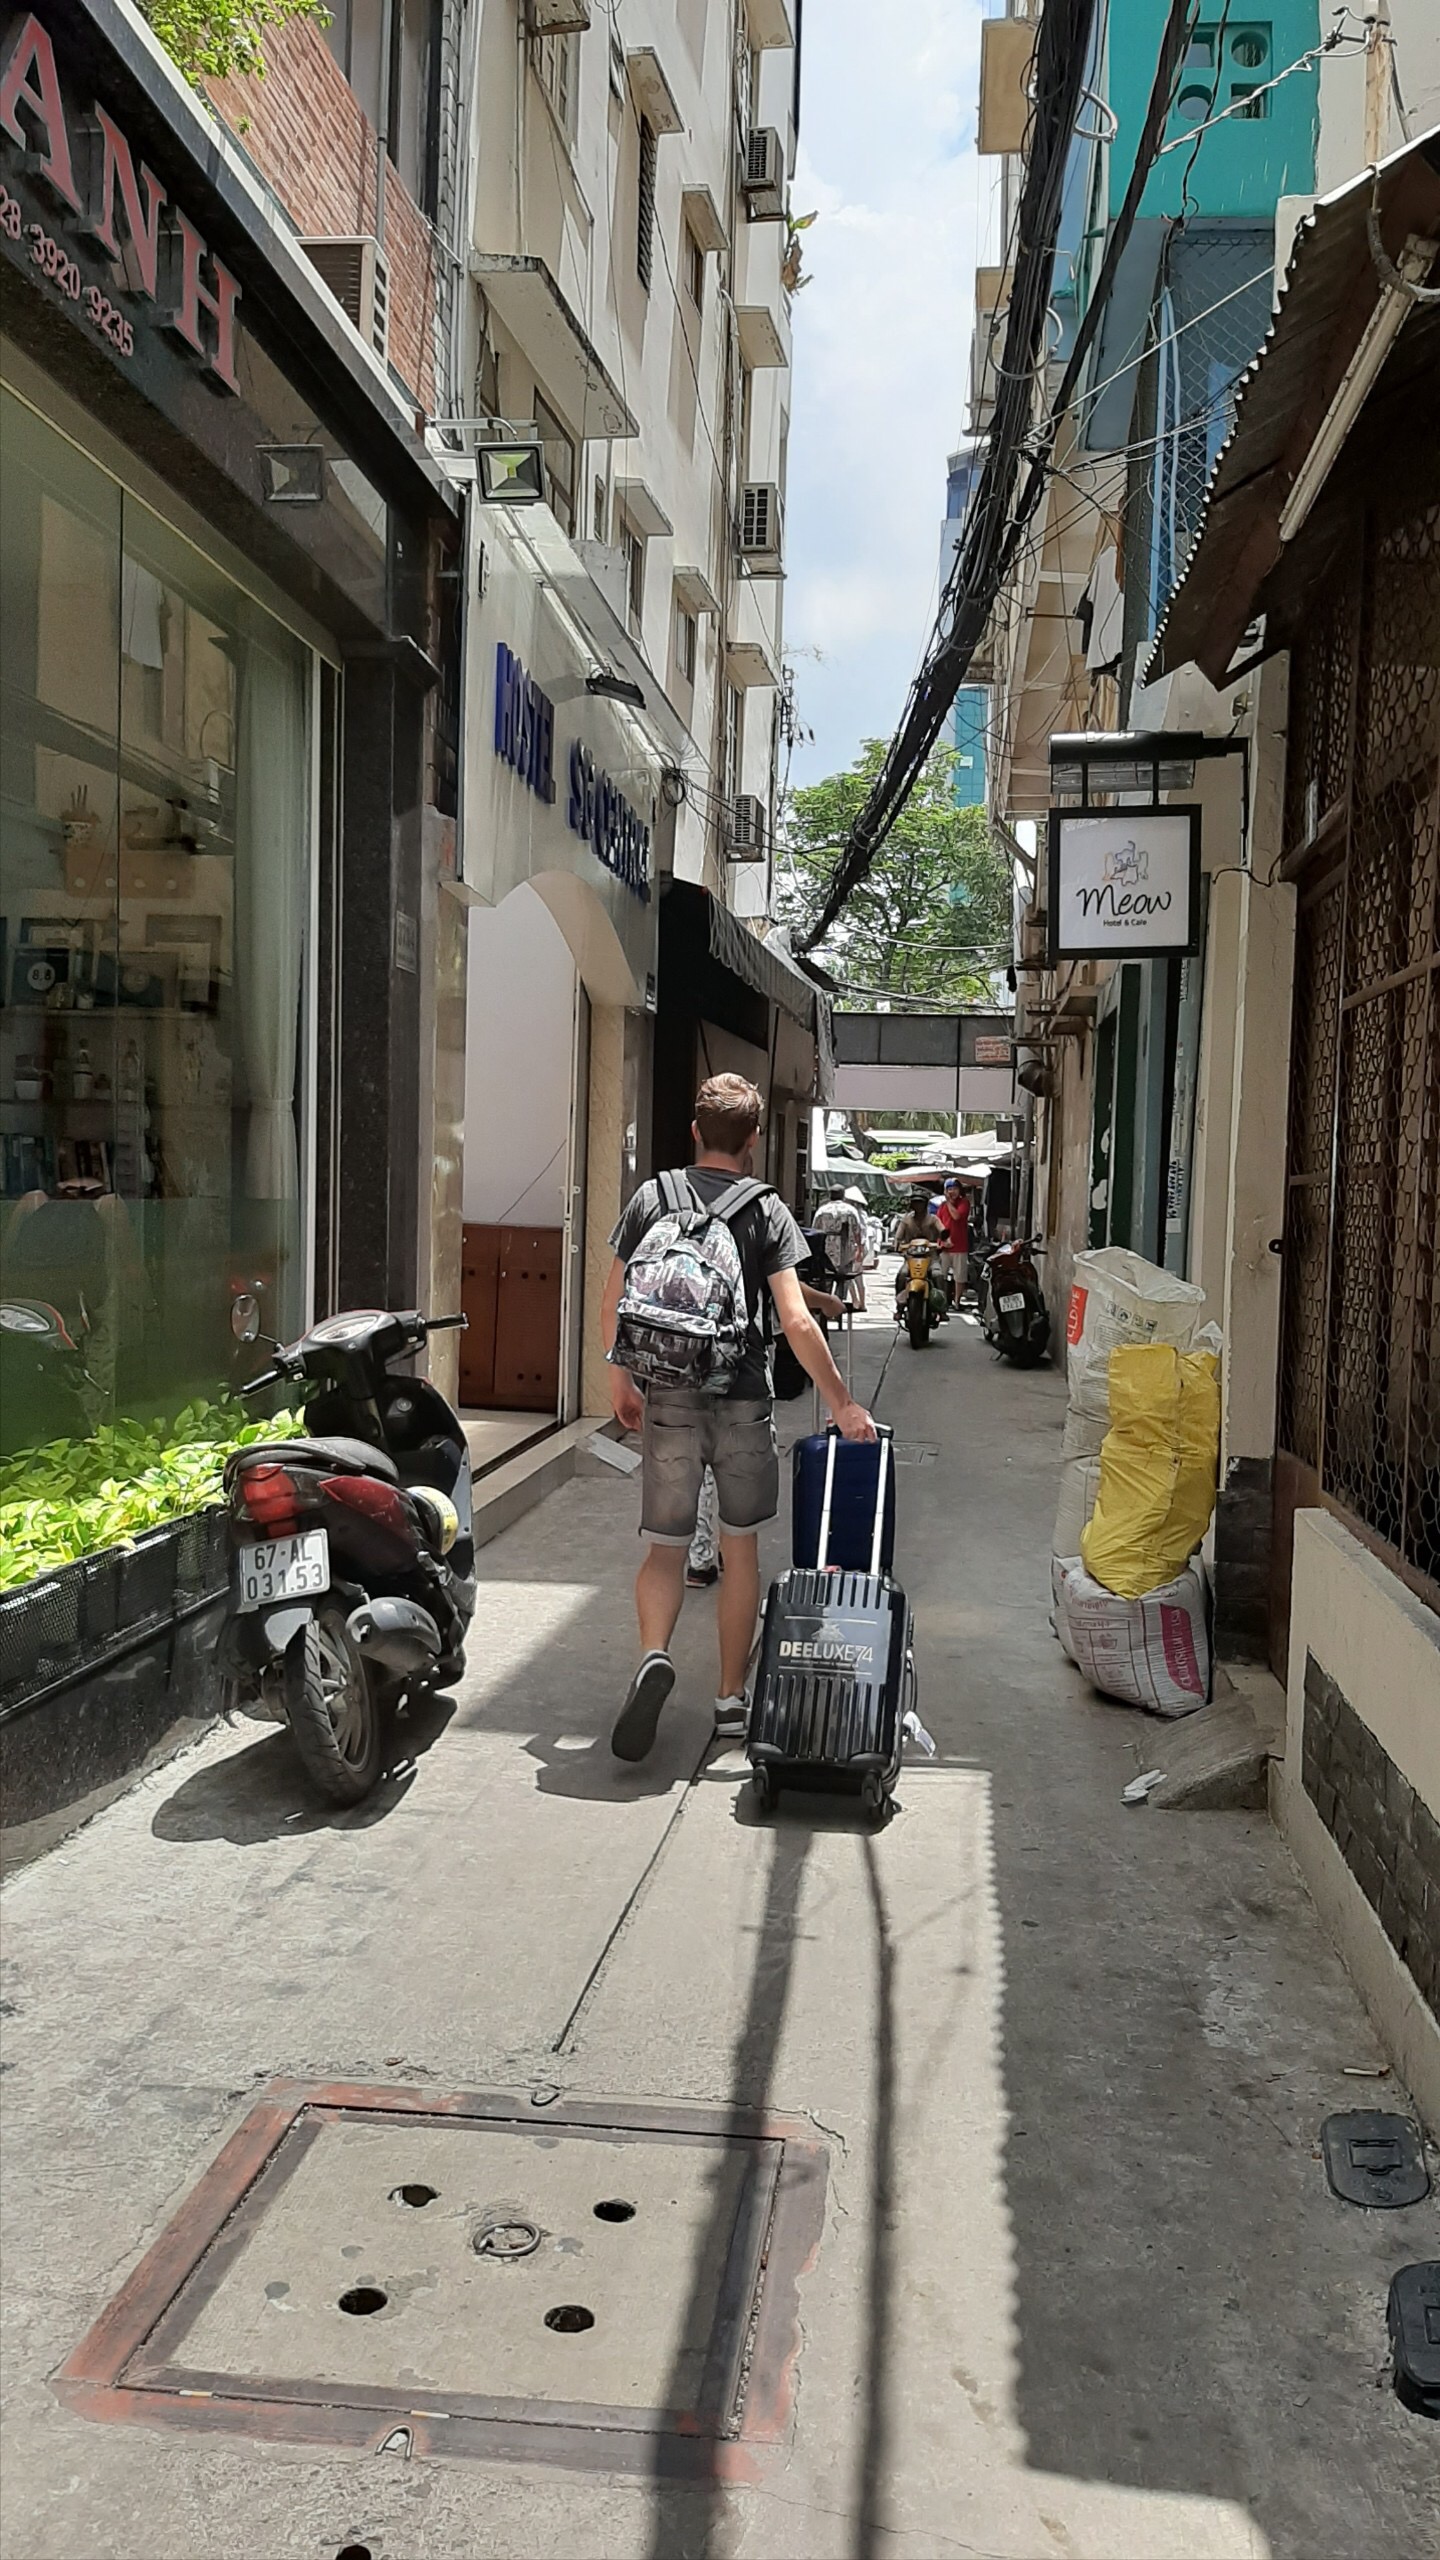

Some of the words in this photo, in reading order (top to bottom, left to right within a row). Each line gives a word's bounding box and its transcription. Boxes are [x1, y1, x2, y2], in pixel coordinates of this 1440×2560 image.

[0, 12, 243, 398] ANH
[27, 223, 80, 301] 3920
[86, 285, 134, 357] 9235
[494, 641, 556, 804] HOSTEL
[247, 1562, 323, 1600] 031.53
